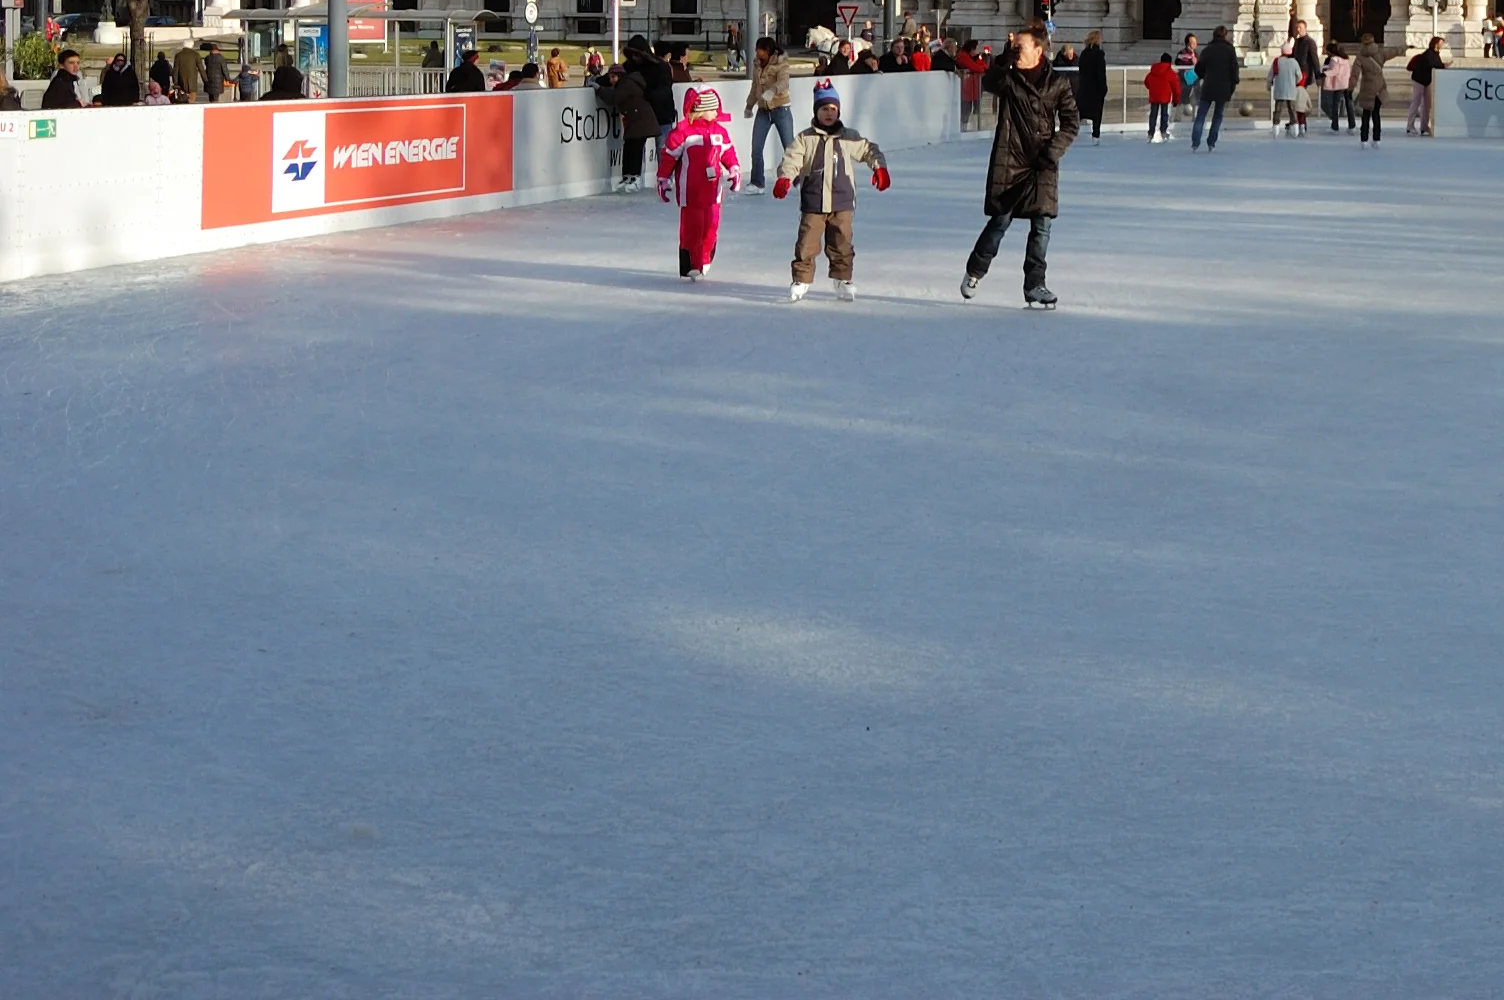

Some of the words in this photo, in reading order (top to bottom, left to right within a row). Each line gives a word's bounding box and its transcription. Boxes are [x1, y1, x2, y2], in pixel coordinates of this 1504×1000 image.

[9, 122, 14, 132] 2
[560, 106, 620, 144] StaDt
[333, 142, 382, 169] WIEN
[384, 136, 460, 165] ENERGIE
